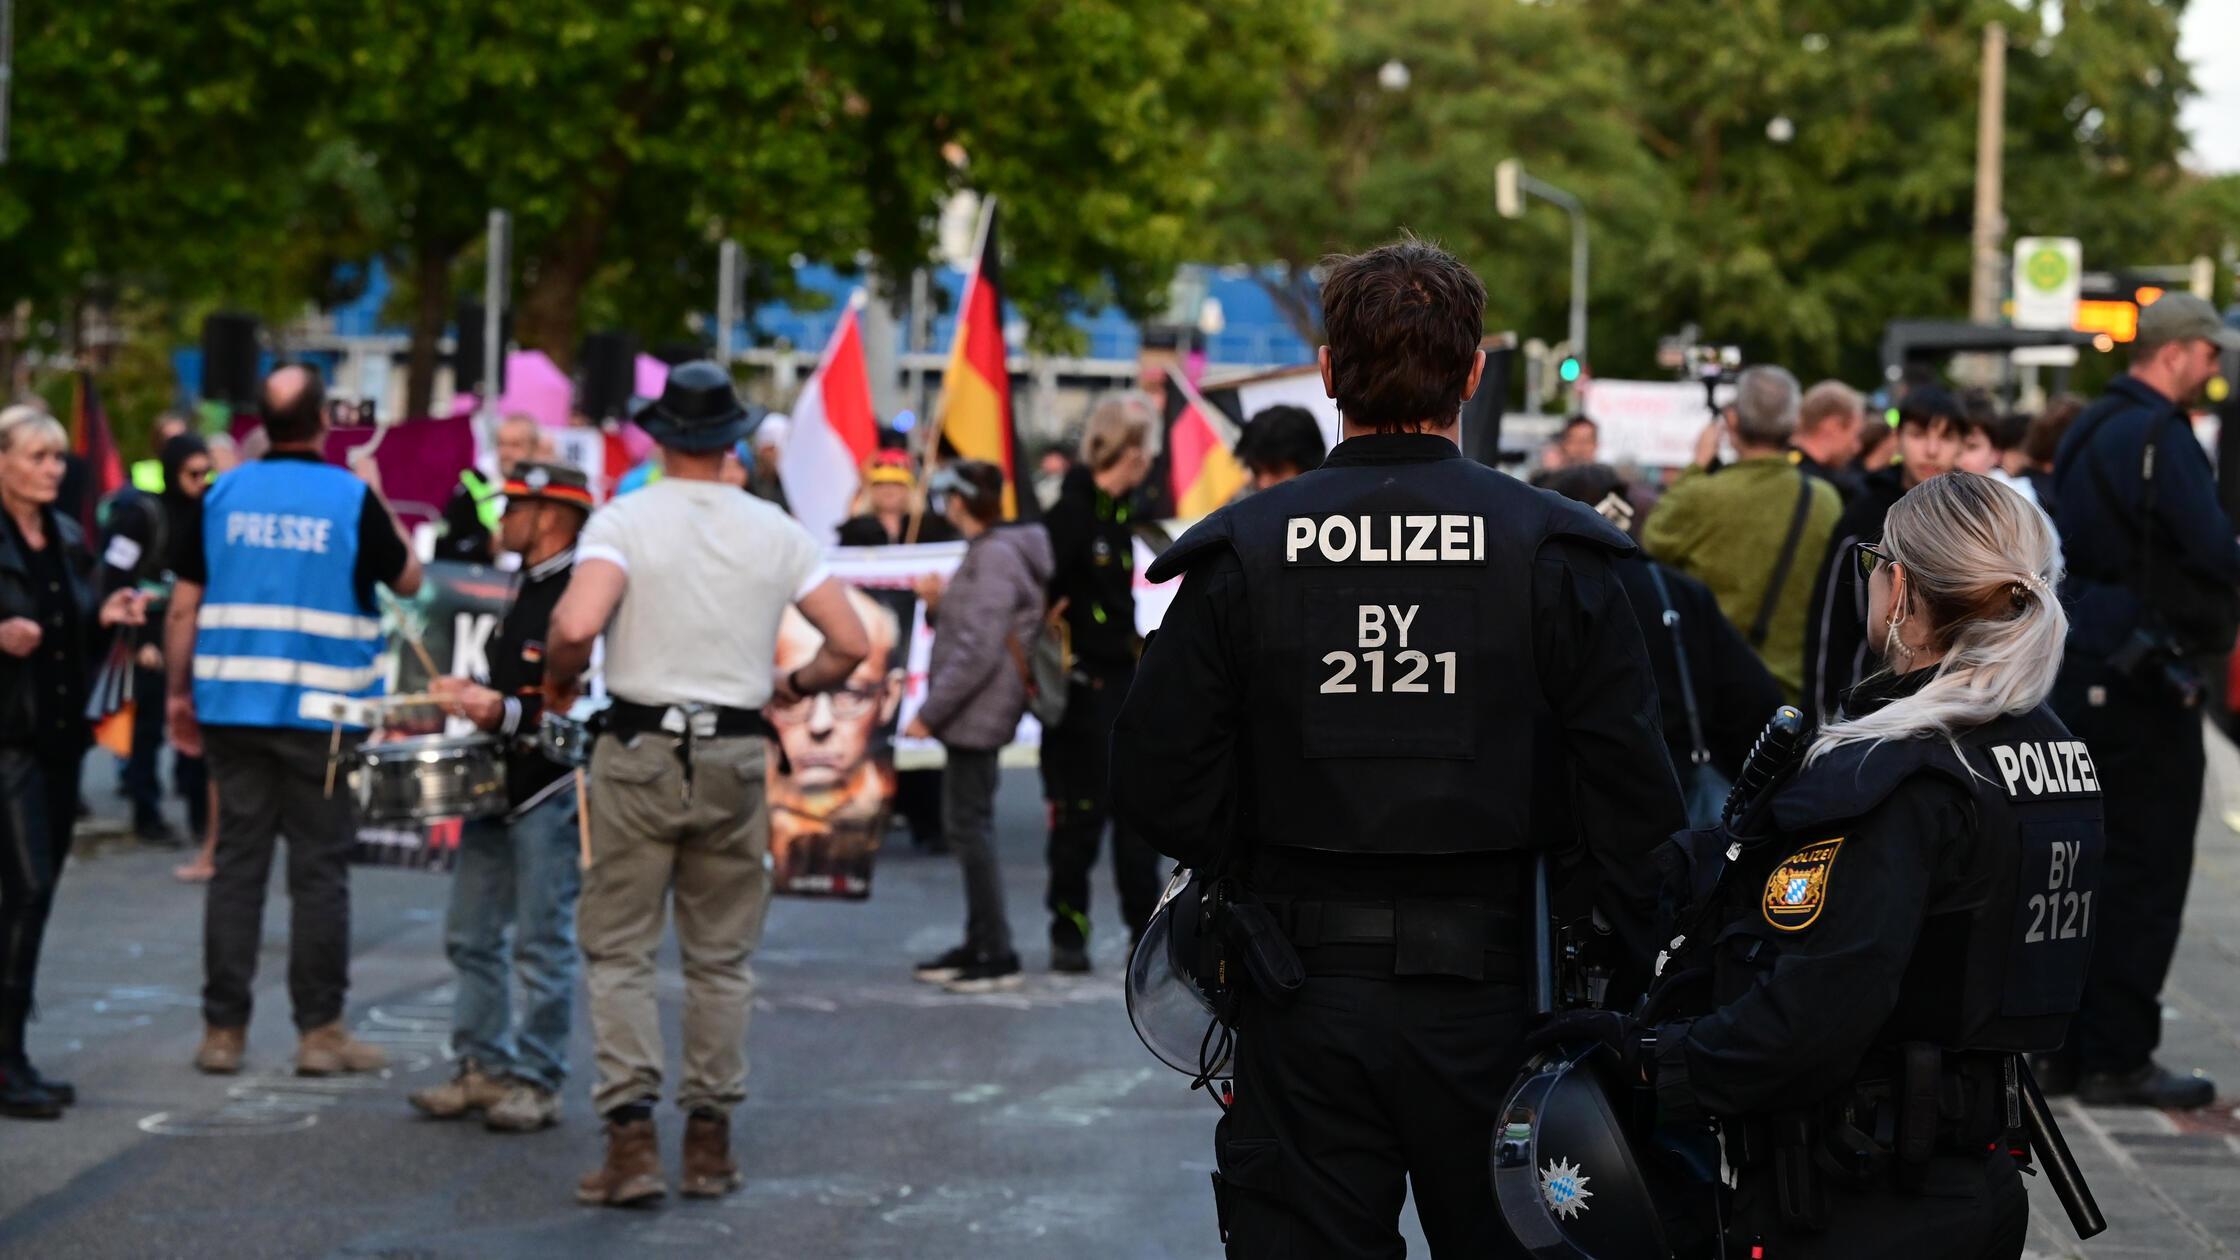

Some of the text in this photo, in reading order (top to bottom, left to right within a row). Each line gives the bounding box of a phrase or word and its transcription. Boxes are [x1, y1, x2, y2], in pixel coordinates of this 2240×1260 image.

[226, 511, 332, 554] PRESSE
[1286, 514, 1485, 562] POLIZEI
[1358, 604, 1420, 648] BY
[1320, 650, 1456, 694] 2121
[1790, 847, 1834, 864] OLIZEI
[2048, 841, 2080, 890] BY
[2025, 891, 2092, 944] 2121
